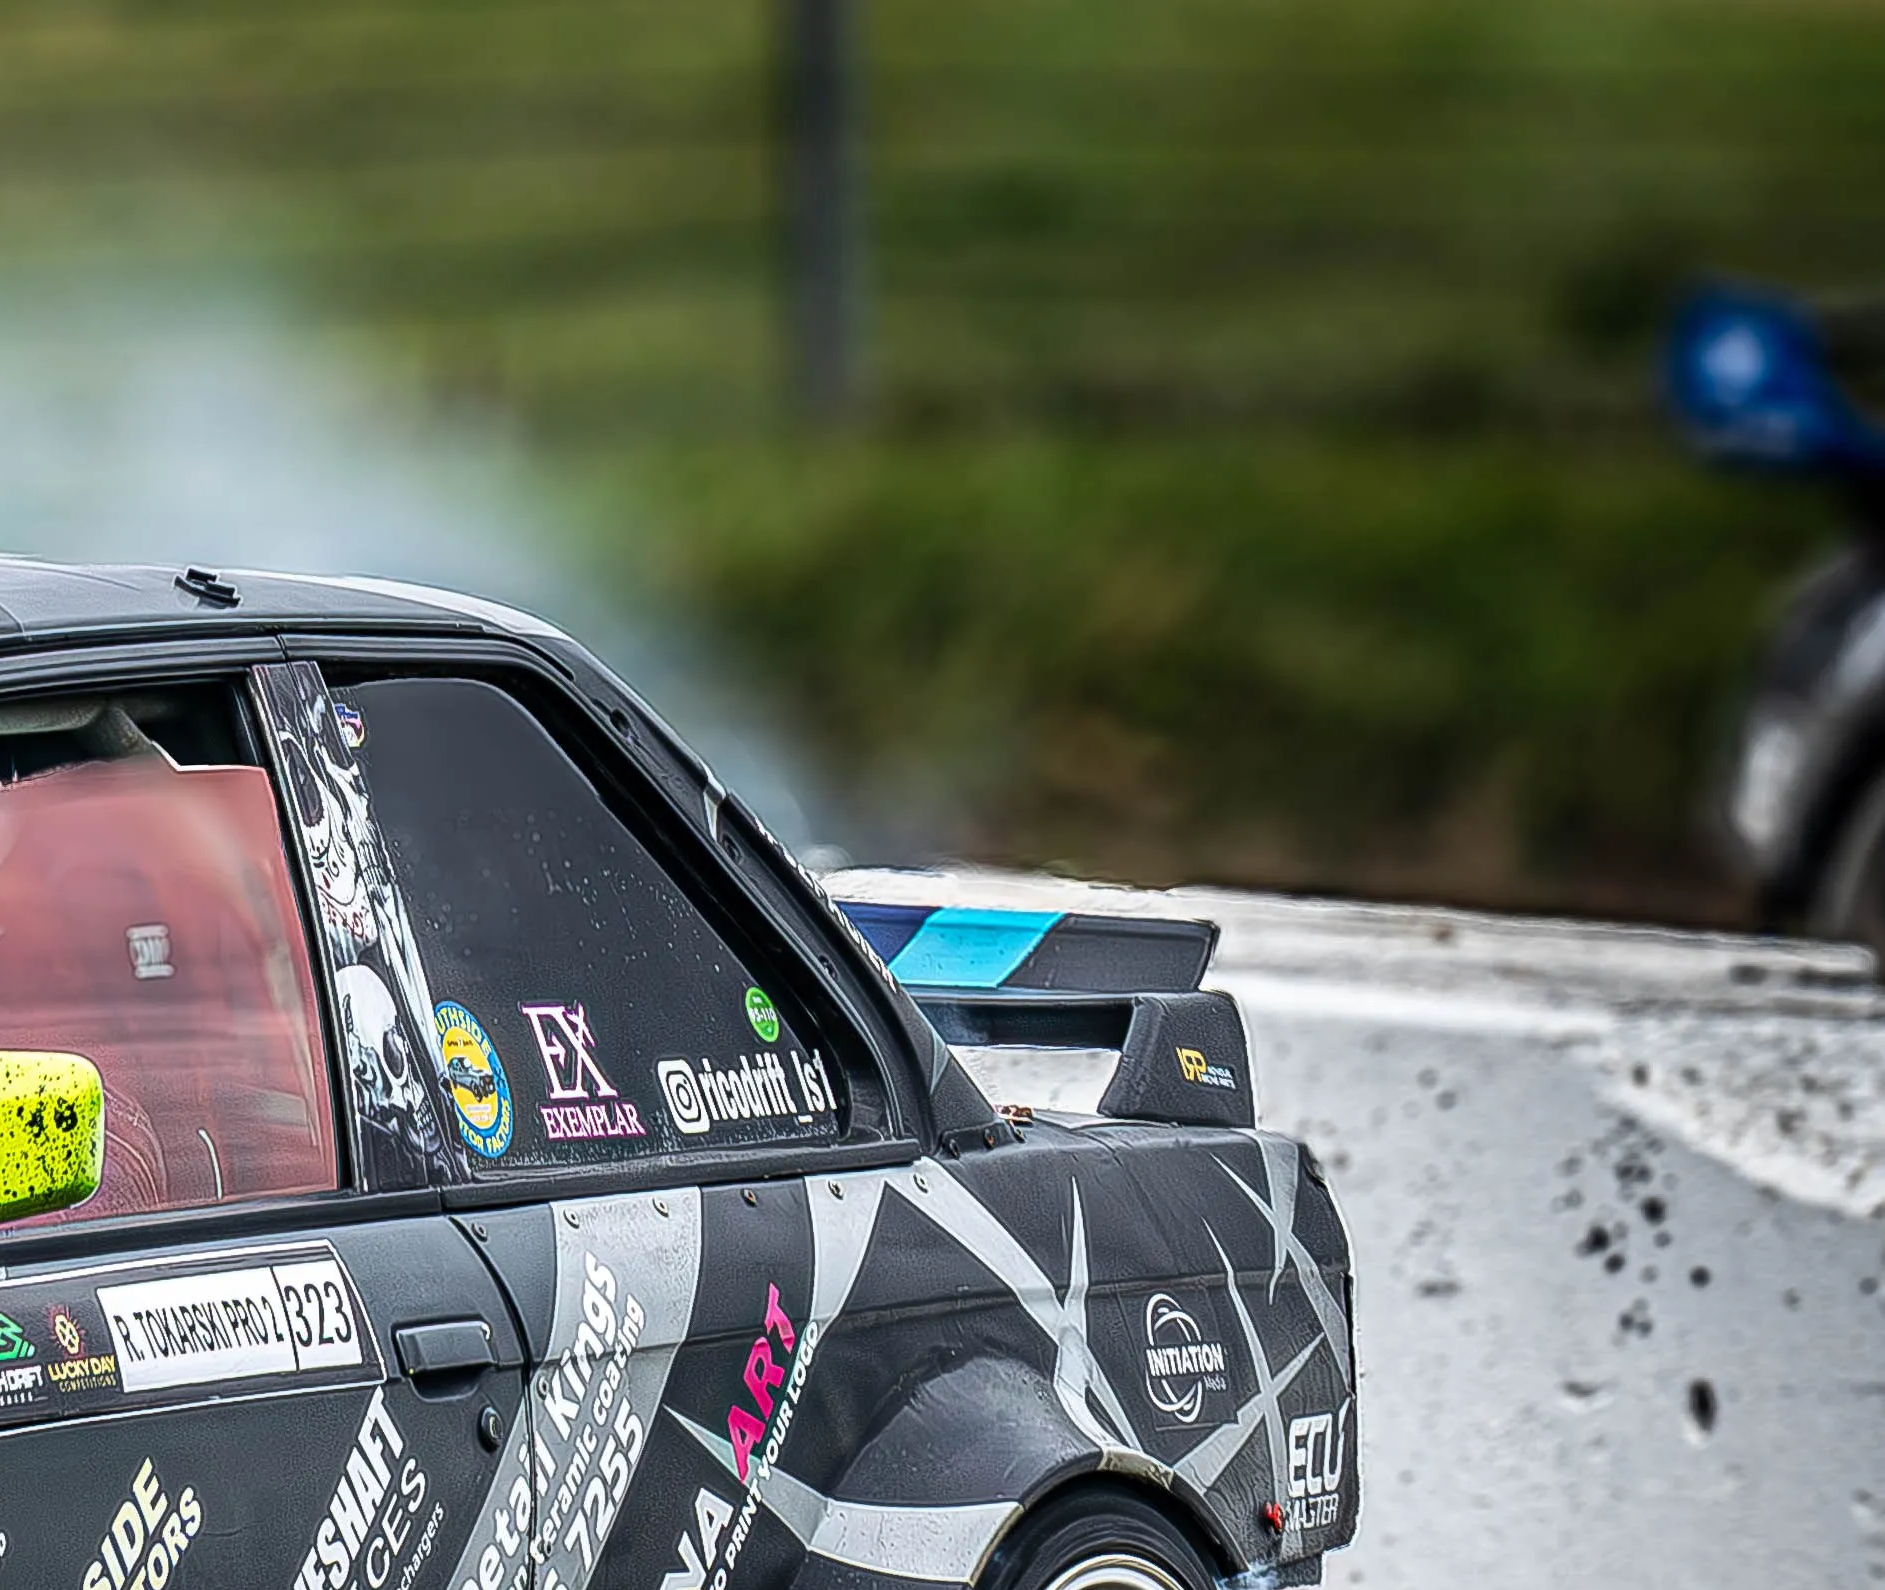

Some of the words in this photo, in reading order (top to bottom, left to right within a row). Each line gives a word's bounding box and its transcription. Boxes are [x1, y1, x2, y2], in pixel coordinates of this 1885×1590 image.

[540, 1103, 647, 1141] EXEMPLAR
[140, 1302, 233, 1358] TOKARSKI
[227, 1297, 269, 1350] PRO
[262, 1296, 284, 1343] 2
[284, 1281, 352, 1347] 323
[543, 1250, 618, 1441] Kings
[592, 1294, 646, 1427] coating
[1146, 1343, 1225, 1377] INITIATION
[47, 1360, 92, 1382] LUCKY
[90, 1354, 116, 1375] DAY
[727, 1281, 796, 1485] ART
[564, 1396, 644, 1574] 7255
[723, 1479, 764, 1573] PRINT
[757, 1403, 794, 1482] YOUR
[786, 1320, 819, 1406] LOGO
[1287, 1396, 1351, 1497] ECU
